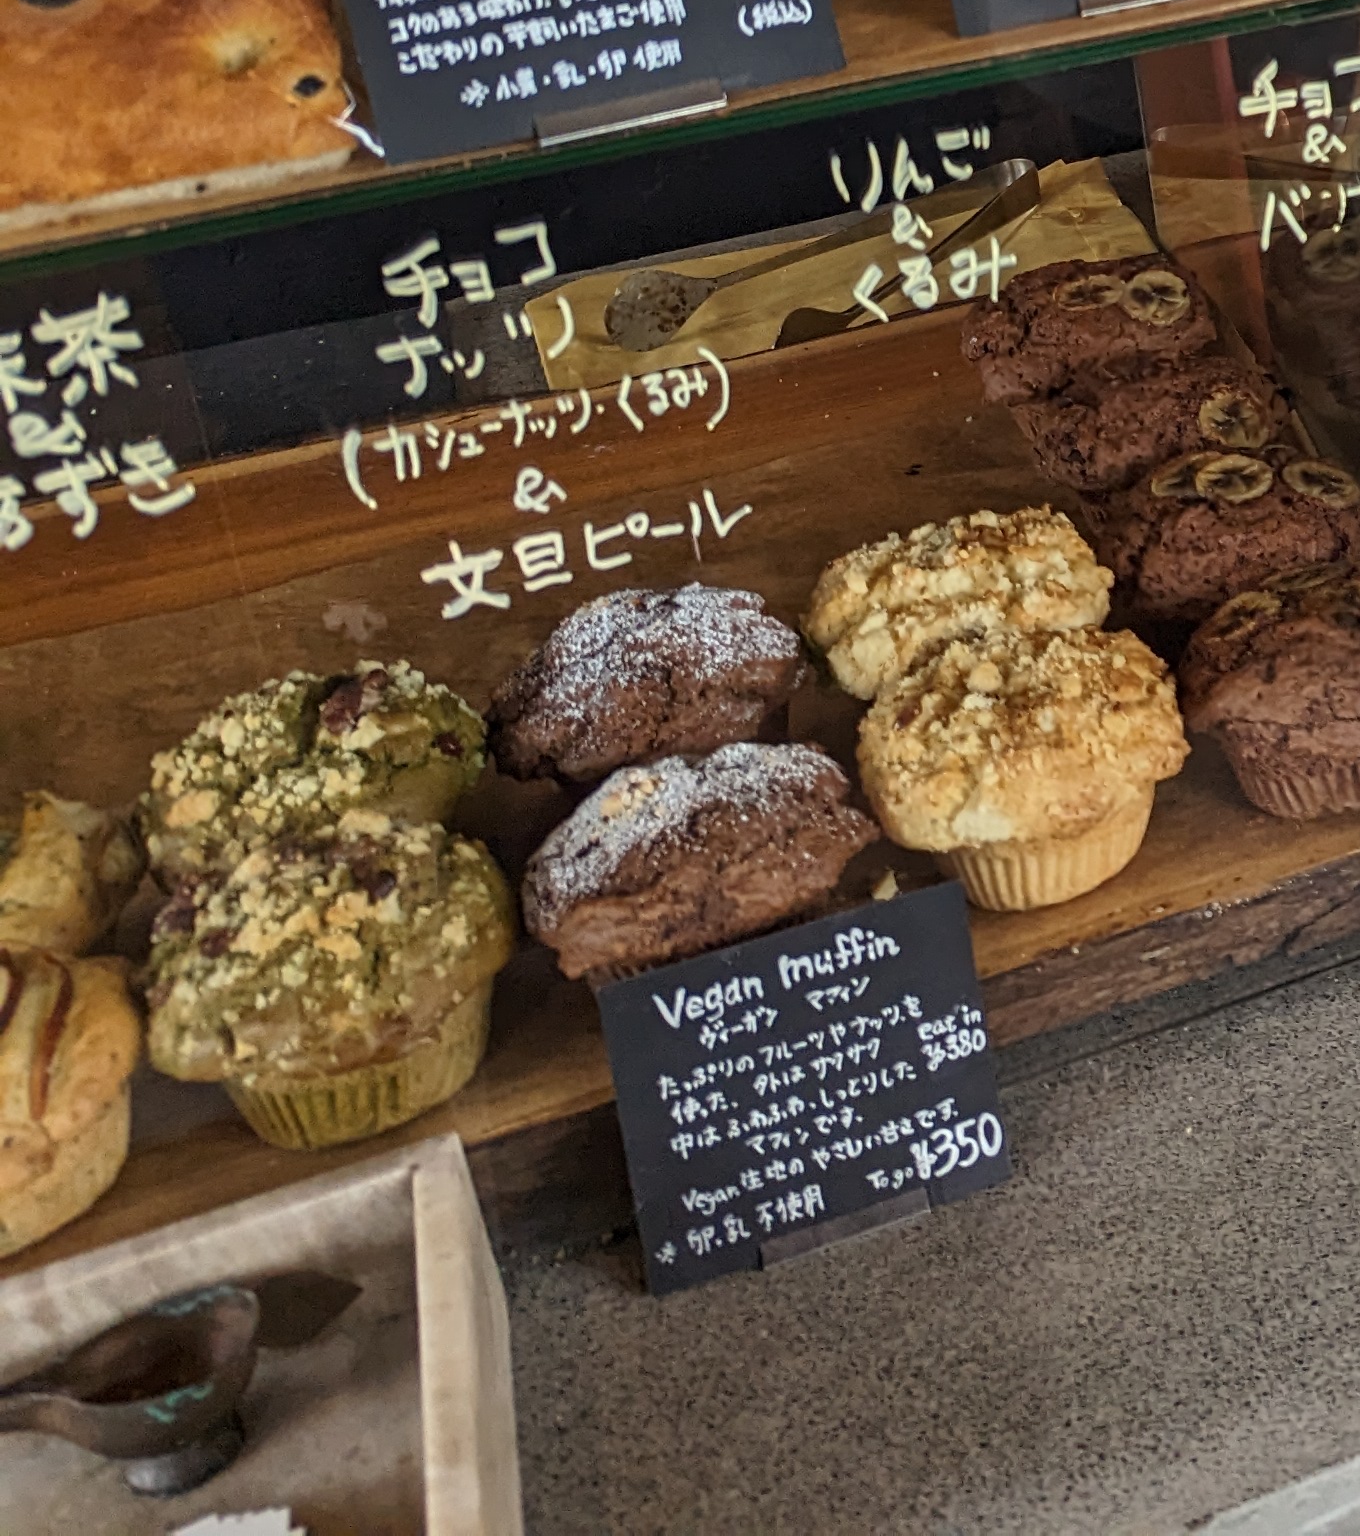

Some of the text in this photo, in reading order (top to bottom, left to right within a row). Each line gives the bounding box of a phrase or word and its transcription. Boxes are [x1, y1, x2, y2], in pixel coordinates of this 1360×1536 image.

[831, 125, 992, 214] りんご
[381, 218, 557, 328] チョコ
[852, 235, 1018, 324] くるみ
[511, 466, 568, 515] &
[420, 486, 755, 622] 文旦ピール
[651, 926, 901, 1029] Vegan muffin
[917, 1014, 957, 1041] eat
[909, 1111, 1004, 1181] ¥350
